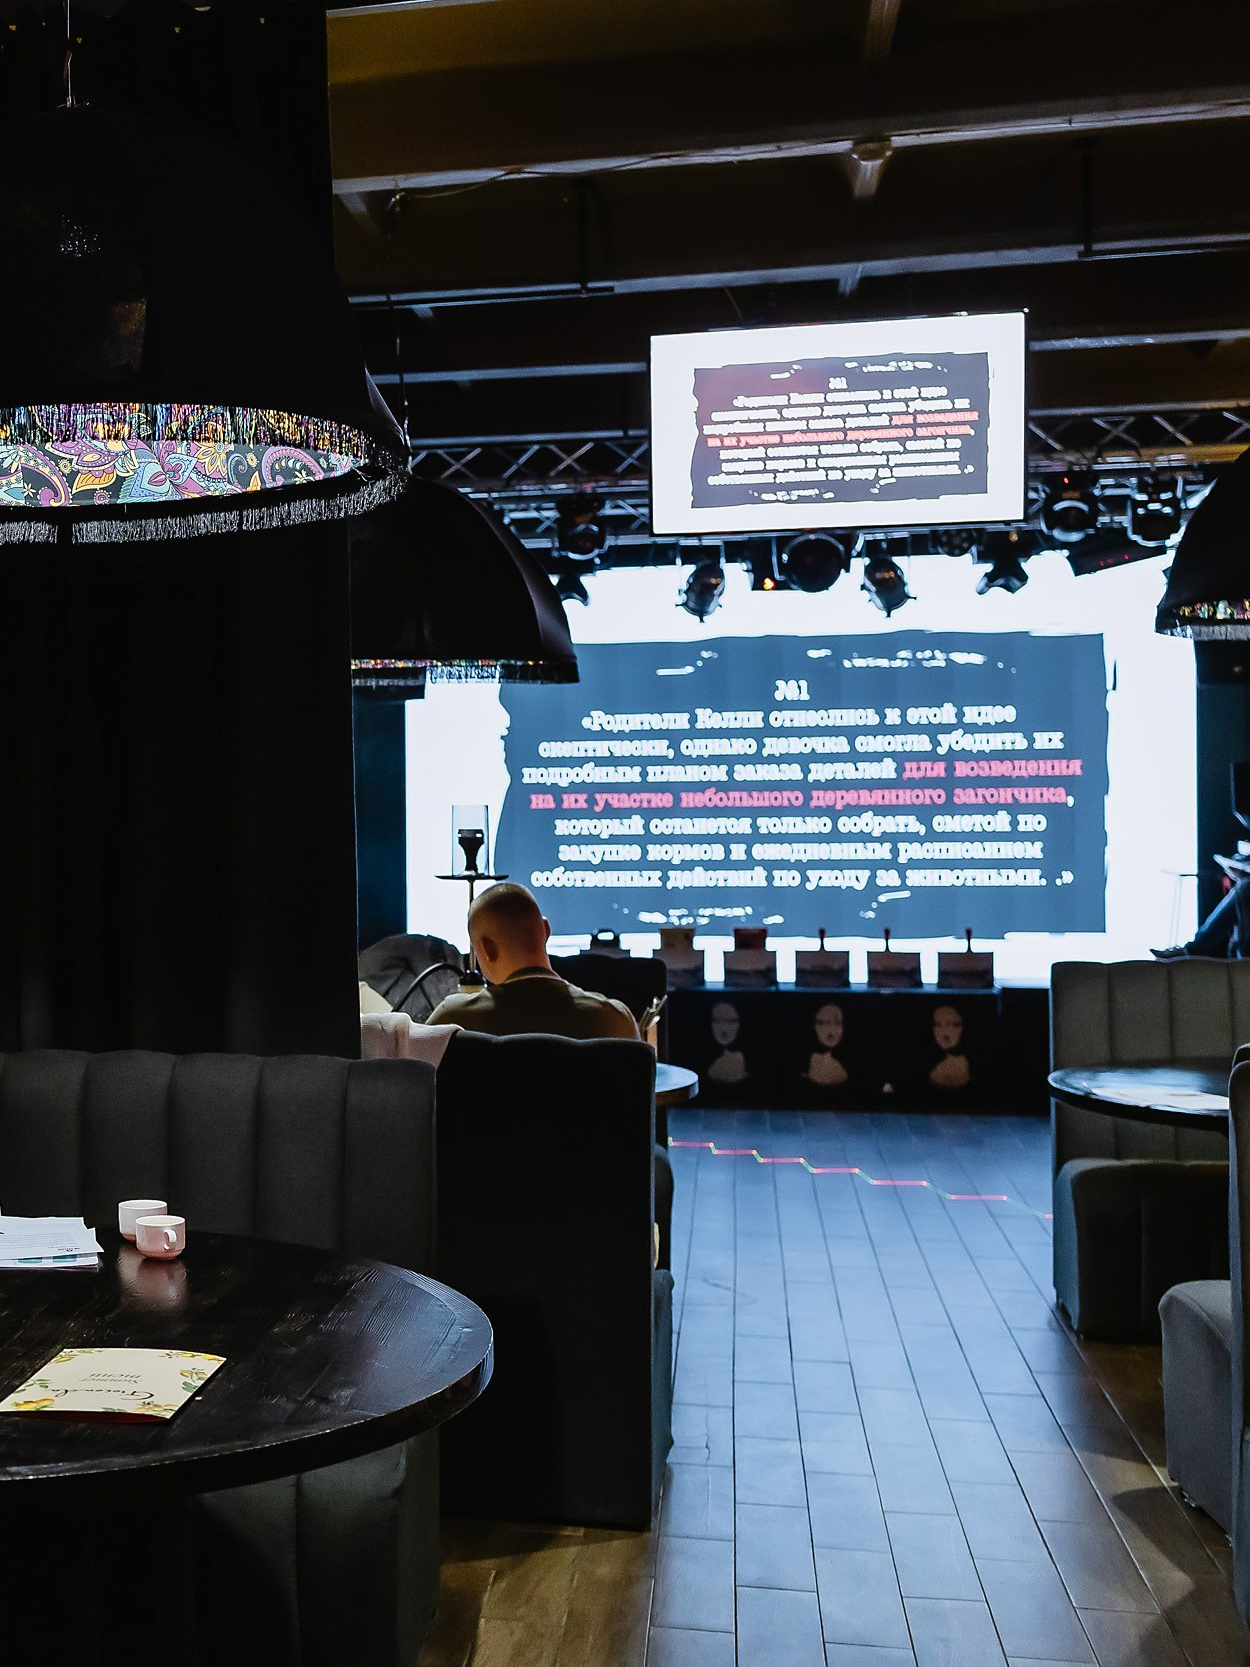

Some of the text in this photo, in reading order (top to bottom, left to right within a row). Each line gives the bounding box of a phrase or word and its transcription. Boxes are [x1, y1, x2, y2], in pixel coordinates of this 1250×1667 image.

[886, 708, 902, 725] к
[908, 703, 958, 725] этой
[964, 706, 1017, 726] идее
[681, 738, 758, 758] однако
[763, 736, 851, 757] девочка
[856, 735, 933, 753] смогла
[938, 729, 1029, 755] убедить
[1034, 732, 1065, 749] их
[522, 758, 1084, 787] подробным планом заказа деталей для возведения
[530, 787, 1075, 812] на их участке небольшого деревянного загончика,
[555, 811, 1047, 838] который останется только собрать, сметой по
[559, 842, 1044, 864] закупке кормов и ежедневным расписанием
[532, 866, 663, 888] собственных
[667, 866, 768, 889] действий
[773, 870, 802, 887] по
[806, 870, 872, 890] уходу
[876, 870, 902, 886] за
